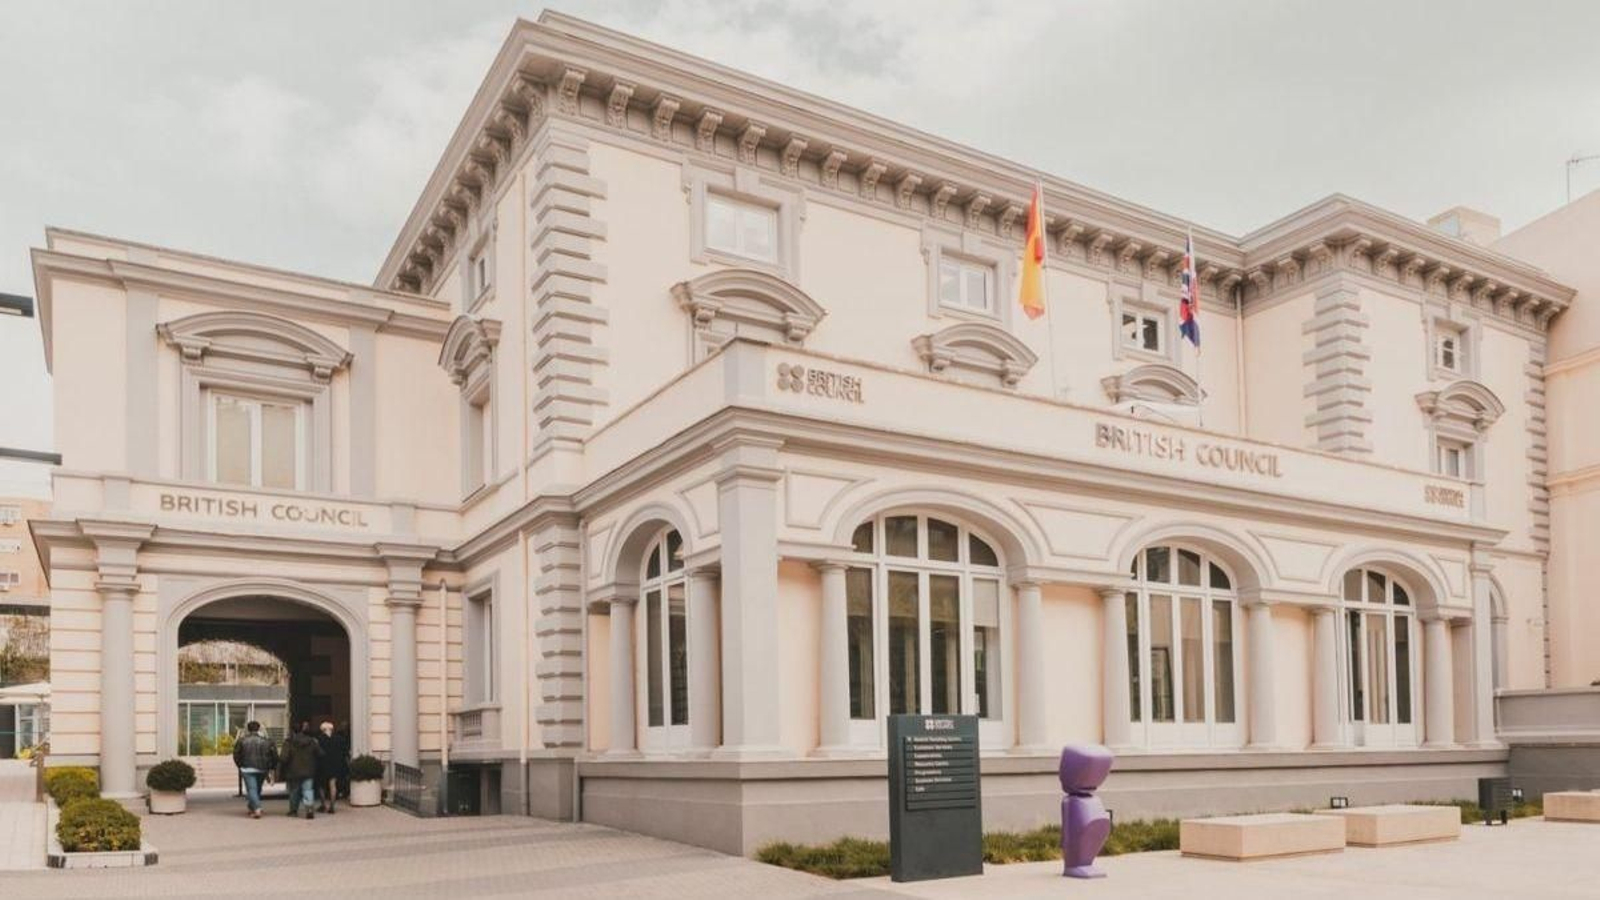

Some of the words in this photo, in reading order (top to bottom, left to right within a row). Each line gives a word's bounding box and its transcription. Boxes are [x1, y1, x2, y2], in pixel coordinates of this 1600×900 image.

[807, 368, 862, 389] BRITISH
[806, 383, 864, 404] COUNCIL
[1095, 422, 1184, 462] BRITISH
[1196, 443, 1283, 478] COUNCIL
[160, 493, 258, 518] BRITISH
[271, 503, 368, 527] COUNCIL
